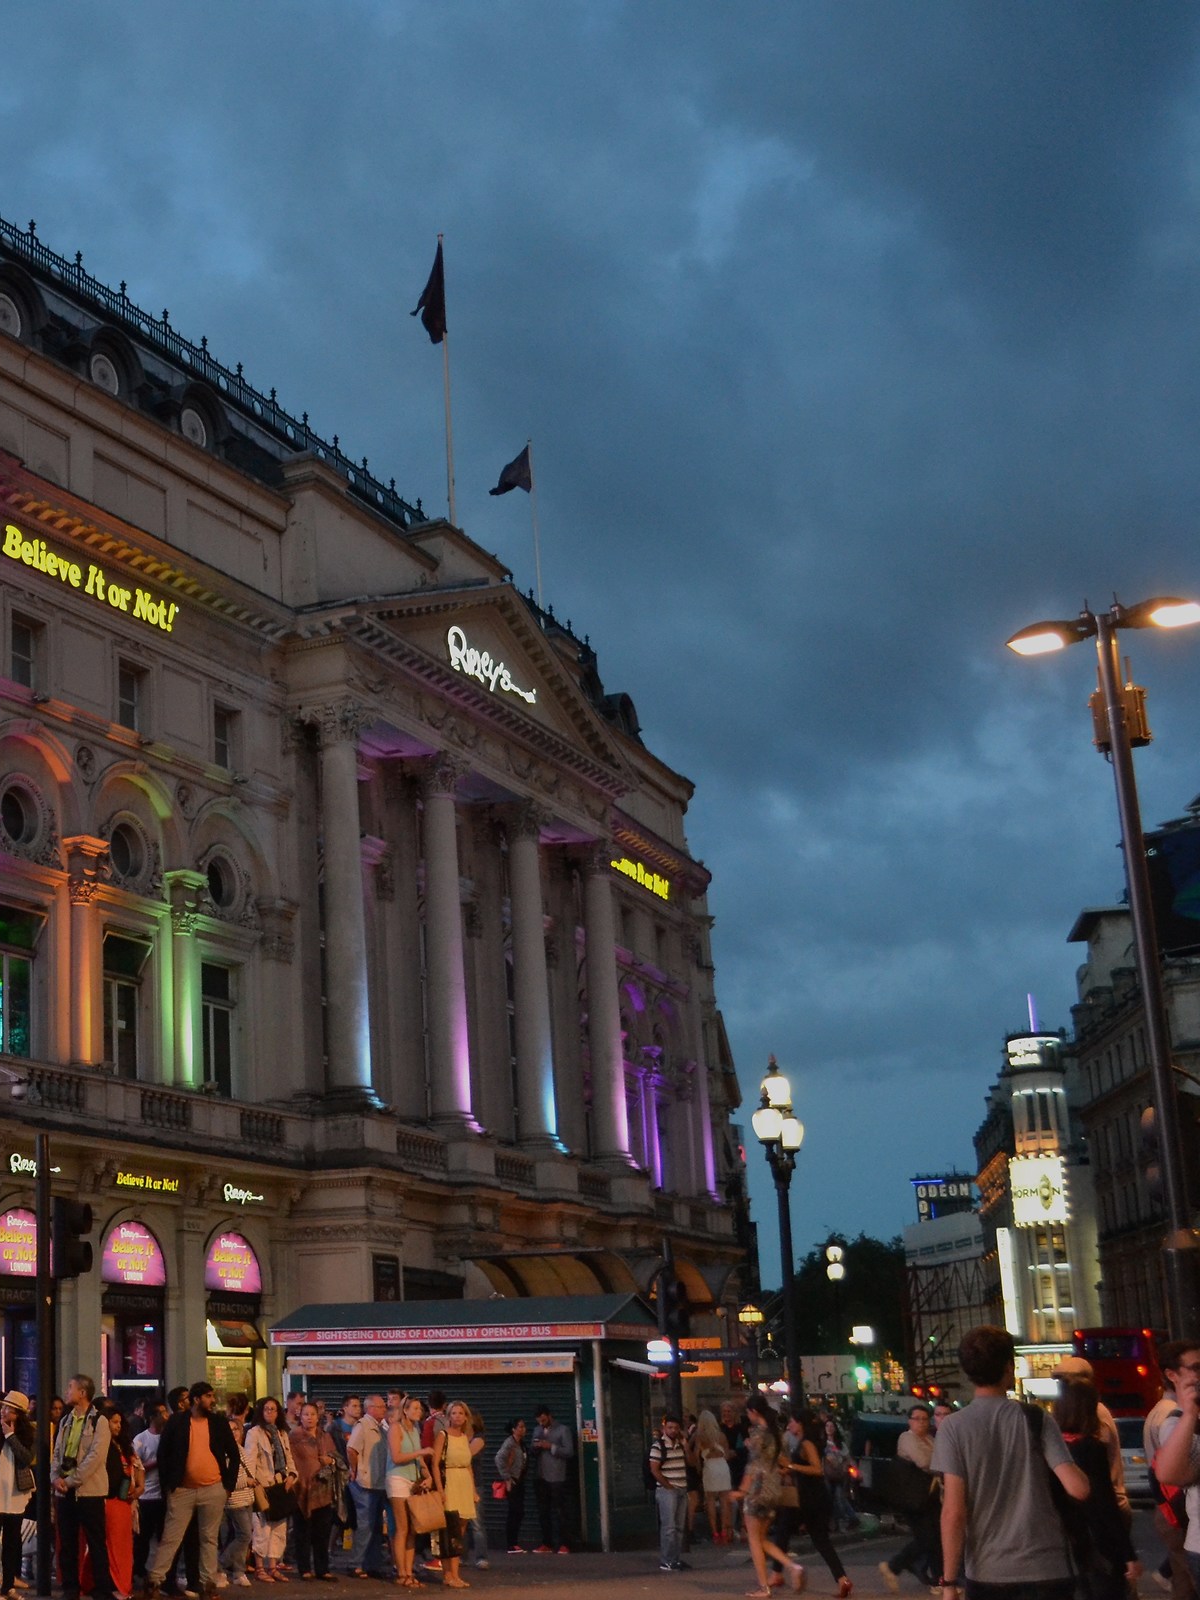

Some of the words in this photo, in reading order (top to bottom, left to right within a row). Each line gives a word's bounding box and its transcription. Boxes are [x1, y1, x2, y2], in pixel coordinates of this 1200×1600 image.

[2, 525, 82, 588] Believe
[84, 564, 105, 600] It
[108, 584, 131, 611] or
[132, 588, 176, 632] Not!
[117, 1172, 145, 1188] Believe
[145, 1175, 153, 1189] It
[153, 1180, 162, 1190] or
[162, 1178, 179, 1191] Not!
[917, 1183, 969, 1198] ODEON
[3, 1249, 14, 1260] or
[112, 1240, 144, 1255] Believe
[145, 1241, 155, 1257] It
[213, 1248, 242, 1264] Believe
[243, 1250, 252, 1265] It
[10, 1262, 32, 1272] LONDON
[117, 1259, 128, 1270] or
[129, 1258, 150, 1271] Not!
[123, 1271, 143, 1281] LONDON
[218, 1267, 227, 1278] or
[228, 1266, 246, 1280] Not!
[224, 1279, 241, 1289] LONDON
[105, 1296, 158, 1308] ATTRACTION
[207, 1302, 255, 1314] ATTRACTION
[316, 1331, 374, 1340] SIGHTSEEING
[376, 1330, 406, 1339] TOURS
[410, 1329, 421, 1338] OF
[423, 1328, 464, 1338] LONDON
[466, 1328, 478, 1337] BY
[481, 1327, 529, 1337] OPEN-TOP
[531, 1325, 550, 1335] BUS
[359, 1361, 407, 1371] TICKETS
[409, 1361, 428, 1371] ON
[431, 1360, 461, 1371] SALE
[464, 1360, 495, 1370] HERE
